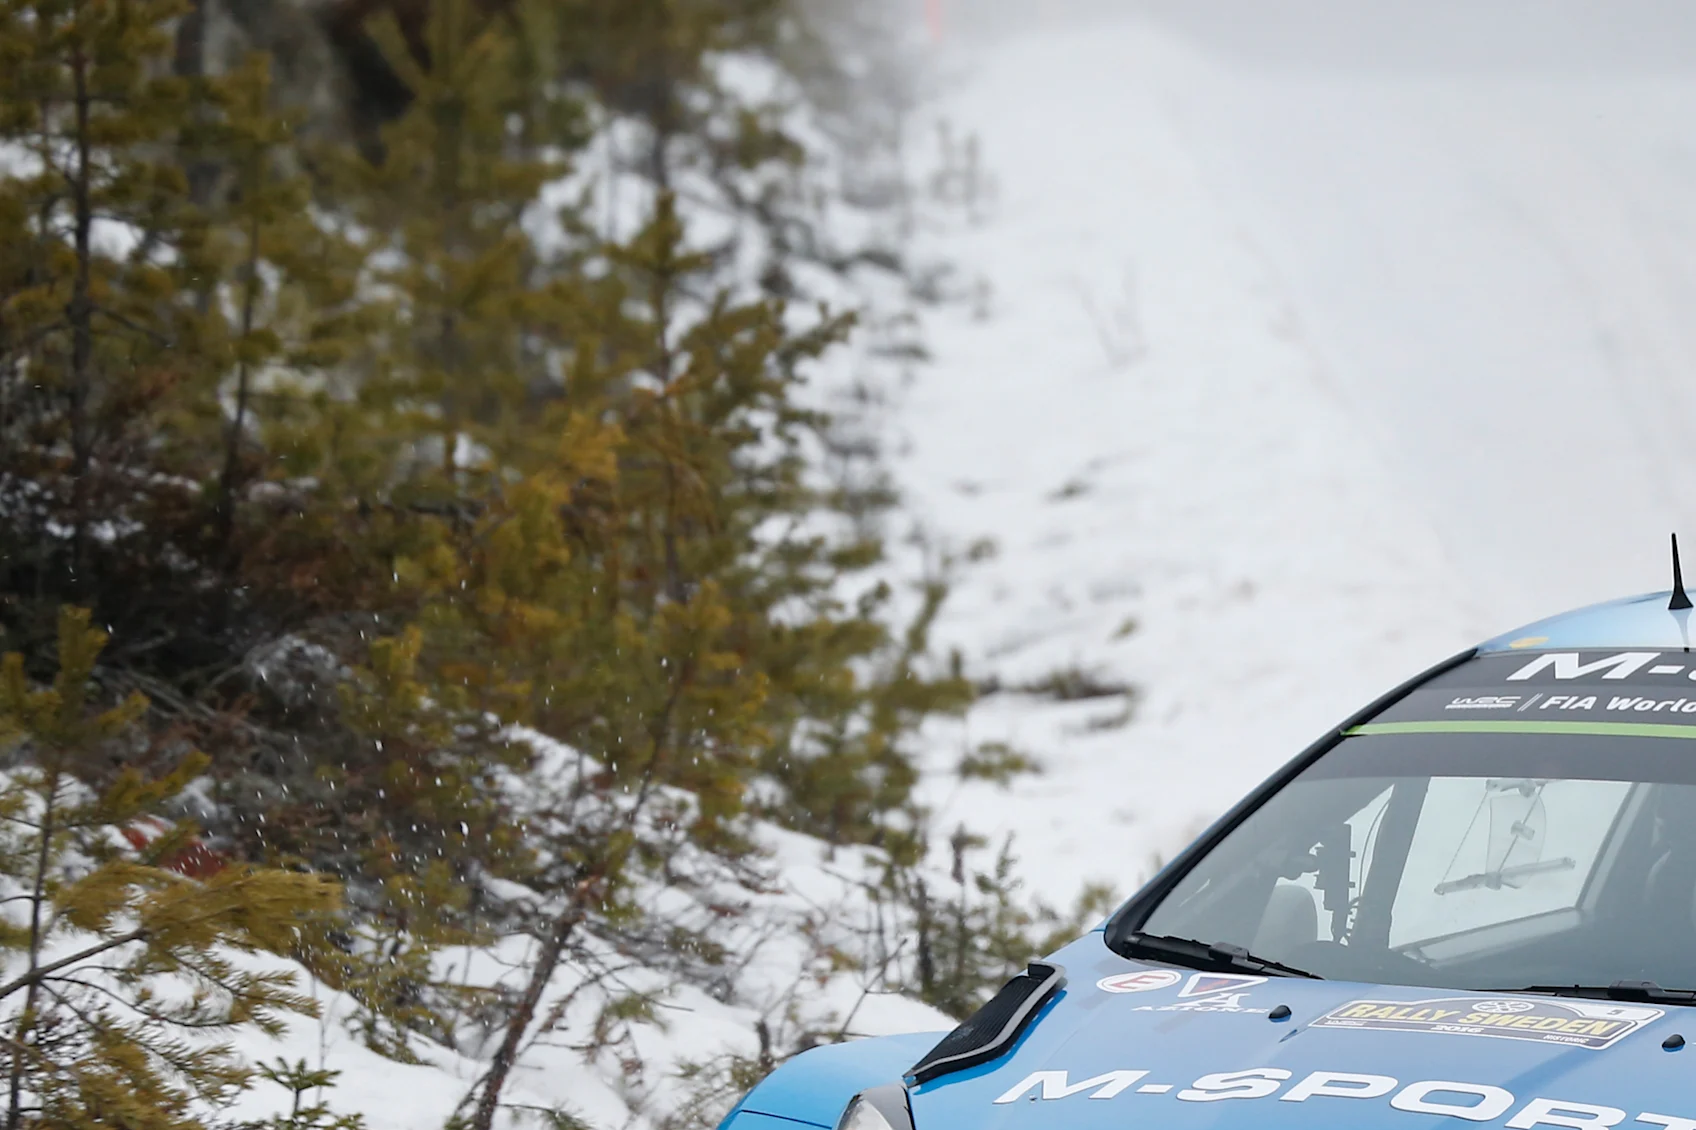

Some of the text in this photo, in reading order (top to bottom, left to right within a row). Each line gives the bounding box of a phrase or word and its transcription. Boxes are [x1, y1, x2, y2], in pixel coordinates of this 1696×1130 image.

[1540, 695, 1597, 710] FIA
[1340, 1003, 1623, 1036] RALLY SWEDEN
[1430, 1024, 1485, 1034] 2016
